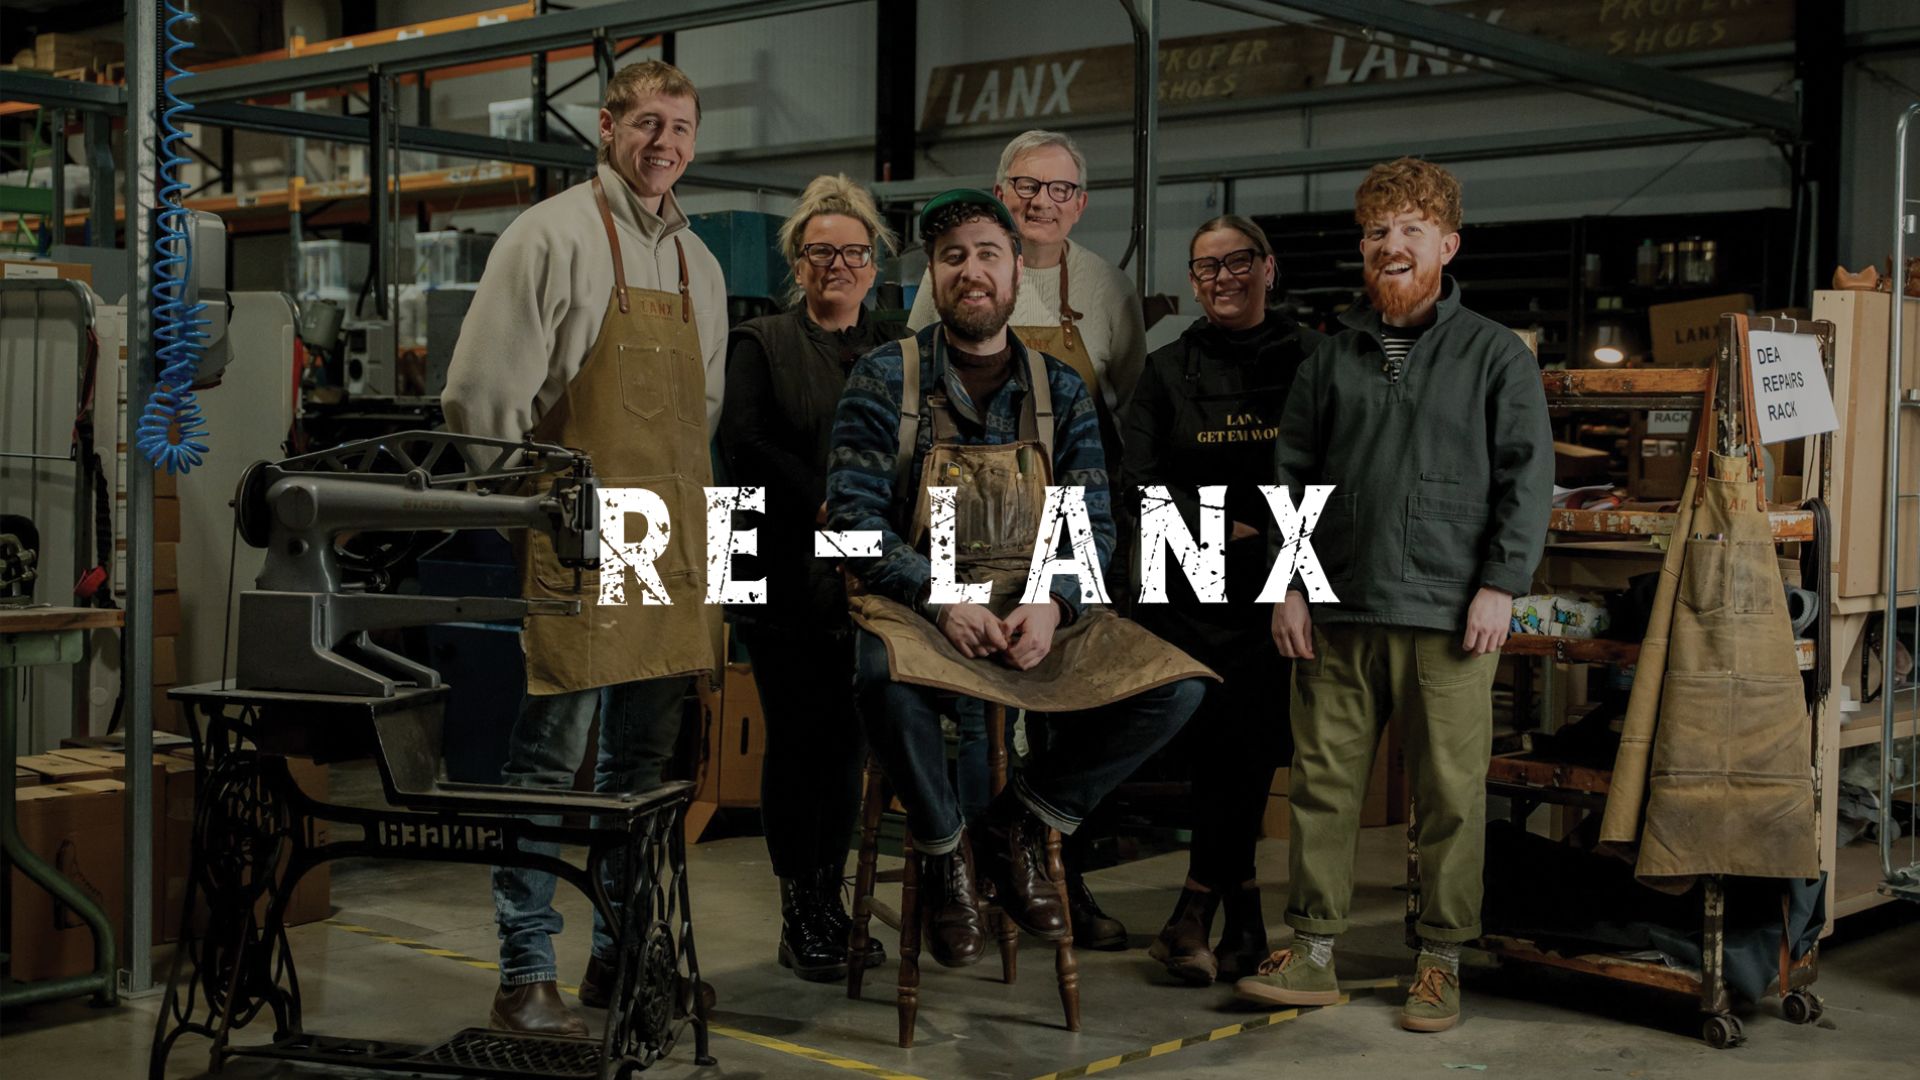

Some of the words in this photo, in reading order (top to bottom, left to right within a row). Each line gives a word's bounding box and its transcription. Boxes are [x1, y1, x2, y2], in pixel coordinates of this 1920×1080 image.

[1607, 17, 1726, 55] SHOES
[945, 59, 1086, 126] LANX
[1757, 346, 1782, 365] DEA
[1762, 371, 1805, 393] REPAIRS
[1654, 412, 1689, 423] RACK
[1767, 401, 1798, 421] RACK
[1196, 431, 1225, 444] GET
